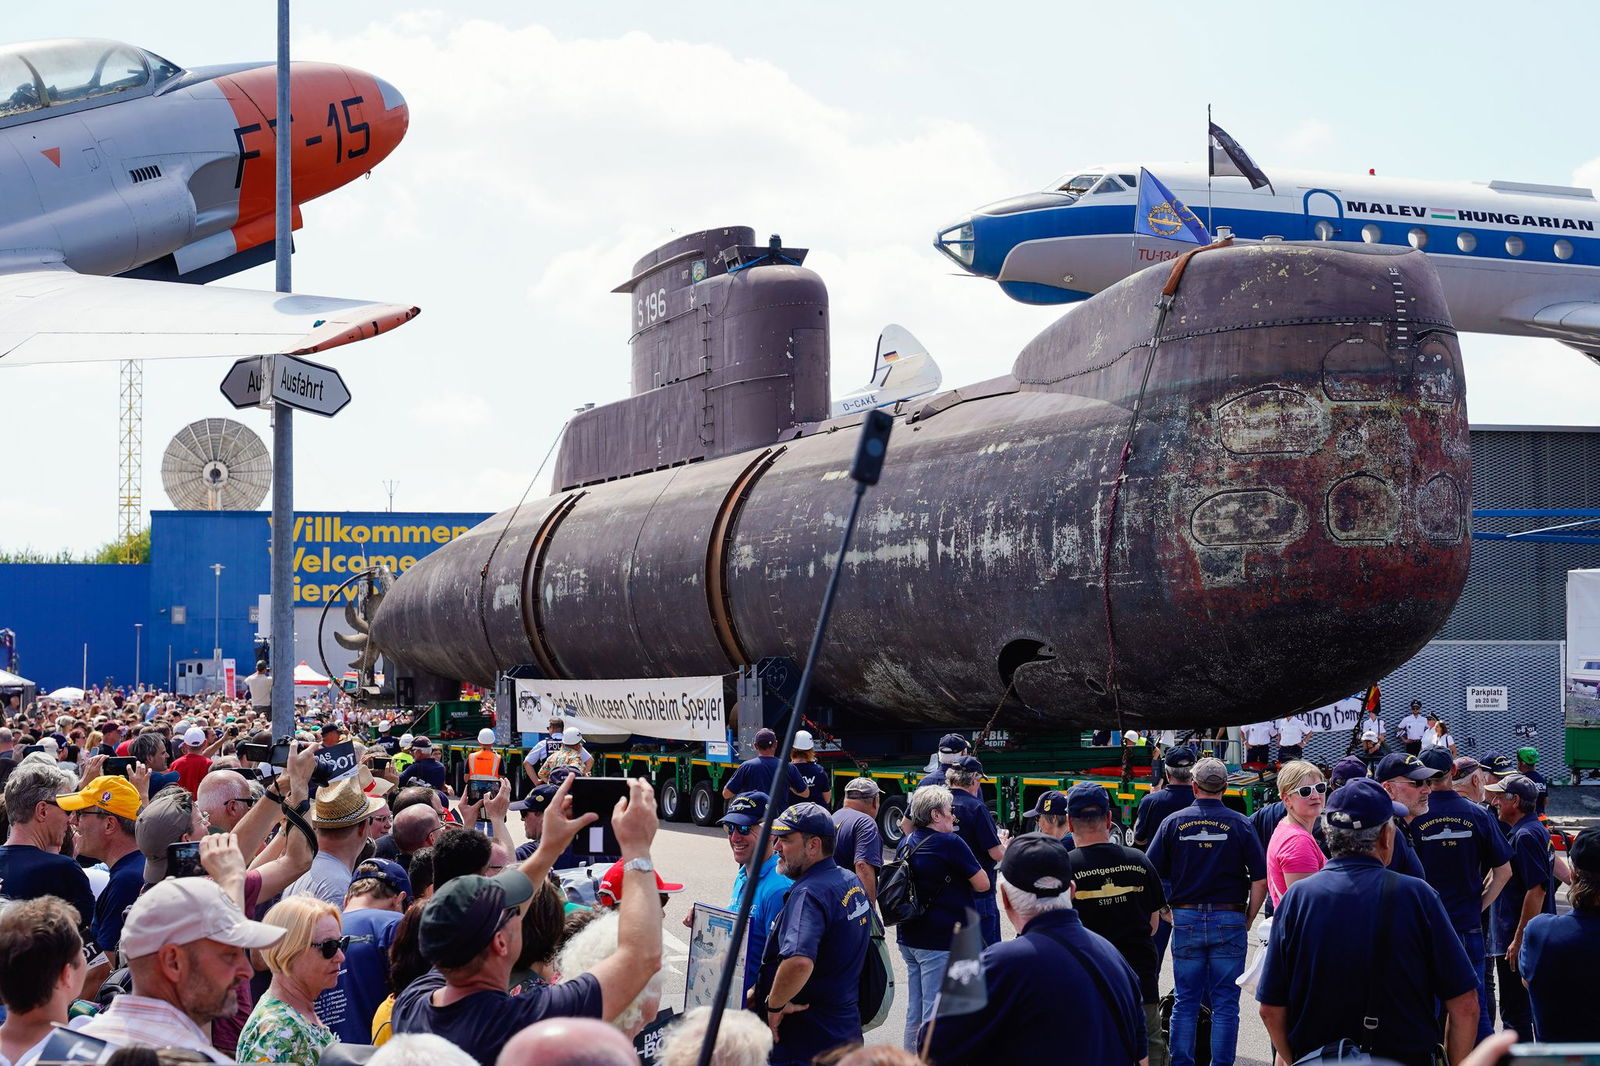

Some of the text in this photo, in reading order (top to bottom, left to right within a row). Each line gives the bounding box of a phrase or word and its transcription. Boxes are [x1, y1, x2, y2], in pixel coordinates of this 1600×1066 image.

[1346, 200, 1595, 231] MALEV HUNGARIAN
[637, 287, 667, 327] S 196
[280, 365, 324, 401] Ausfahrt
[842, 393, 879, 411] D-CAKE
[1471, 688, 1503, 697] Parkplatz
[584, 694, 628, 720] Museen
[626, 692, 681, 721] Sinsheim
[681, 692, 722, 729] Speyer
[1178, 819, 1231, 832] Unterseeboot U17
[1418, 816, 1474, 831] Unterseeboot U17
[1074, 864, 1147, 880] Ubootgeschwader
[644, 1027, 664, 1044] DAS
